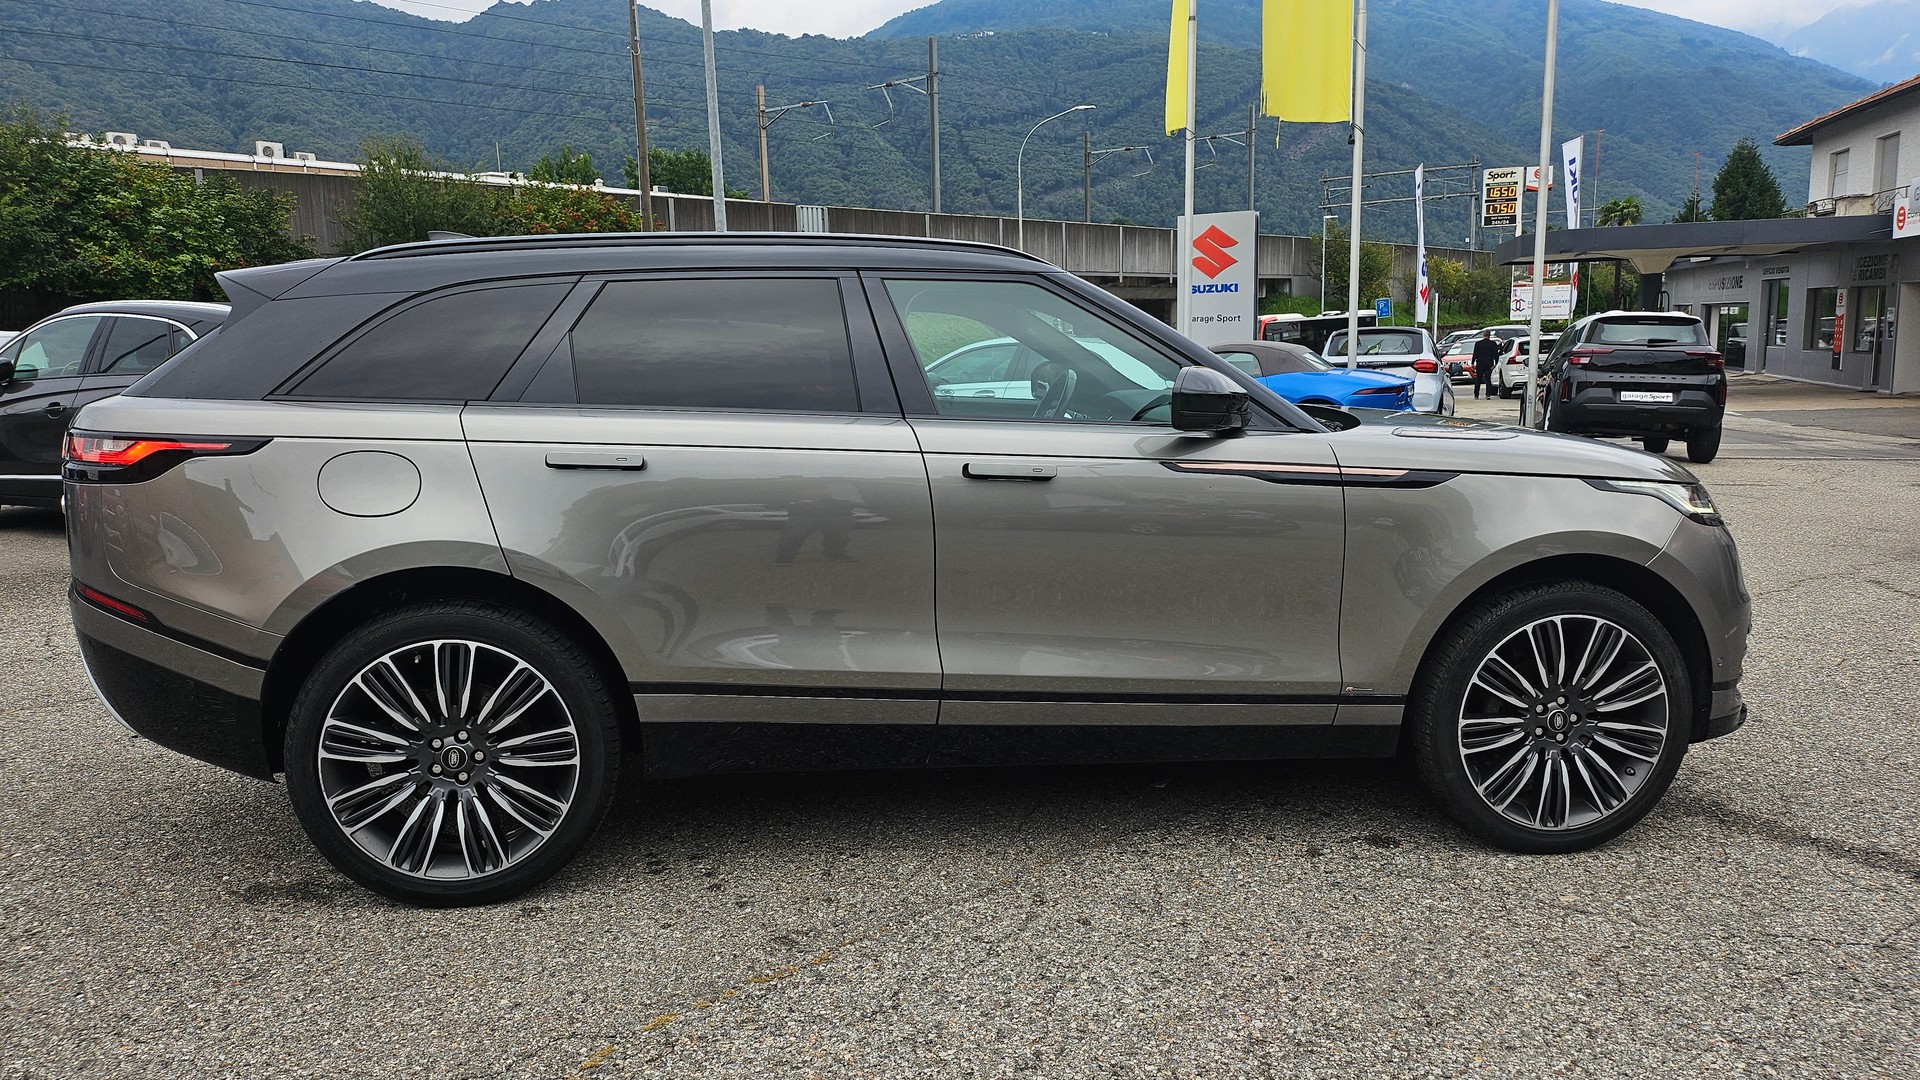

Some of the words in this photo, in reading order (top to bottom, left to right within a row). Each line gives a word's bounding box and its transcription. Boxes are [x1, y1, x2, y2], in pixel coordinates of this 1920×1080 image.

[1487, 170, 1517, 181] Sport
[1858, 267, 1887, 281] RICAMBI
[1192, 283, 1238, 294] SUZUKI
[1192, 316, 1214, 324] arage
[1216, 313, 1241, 323] Sport
